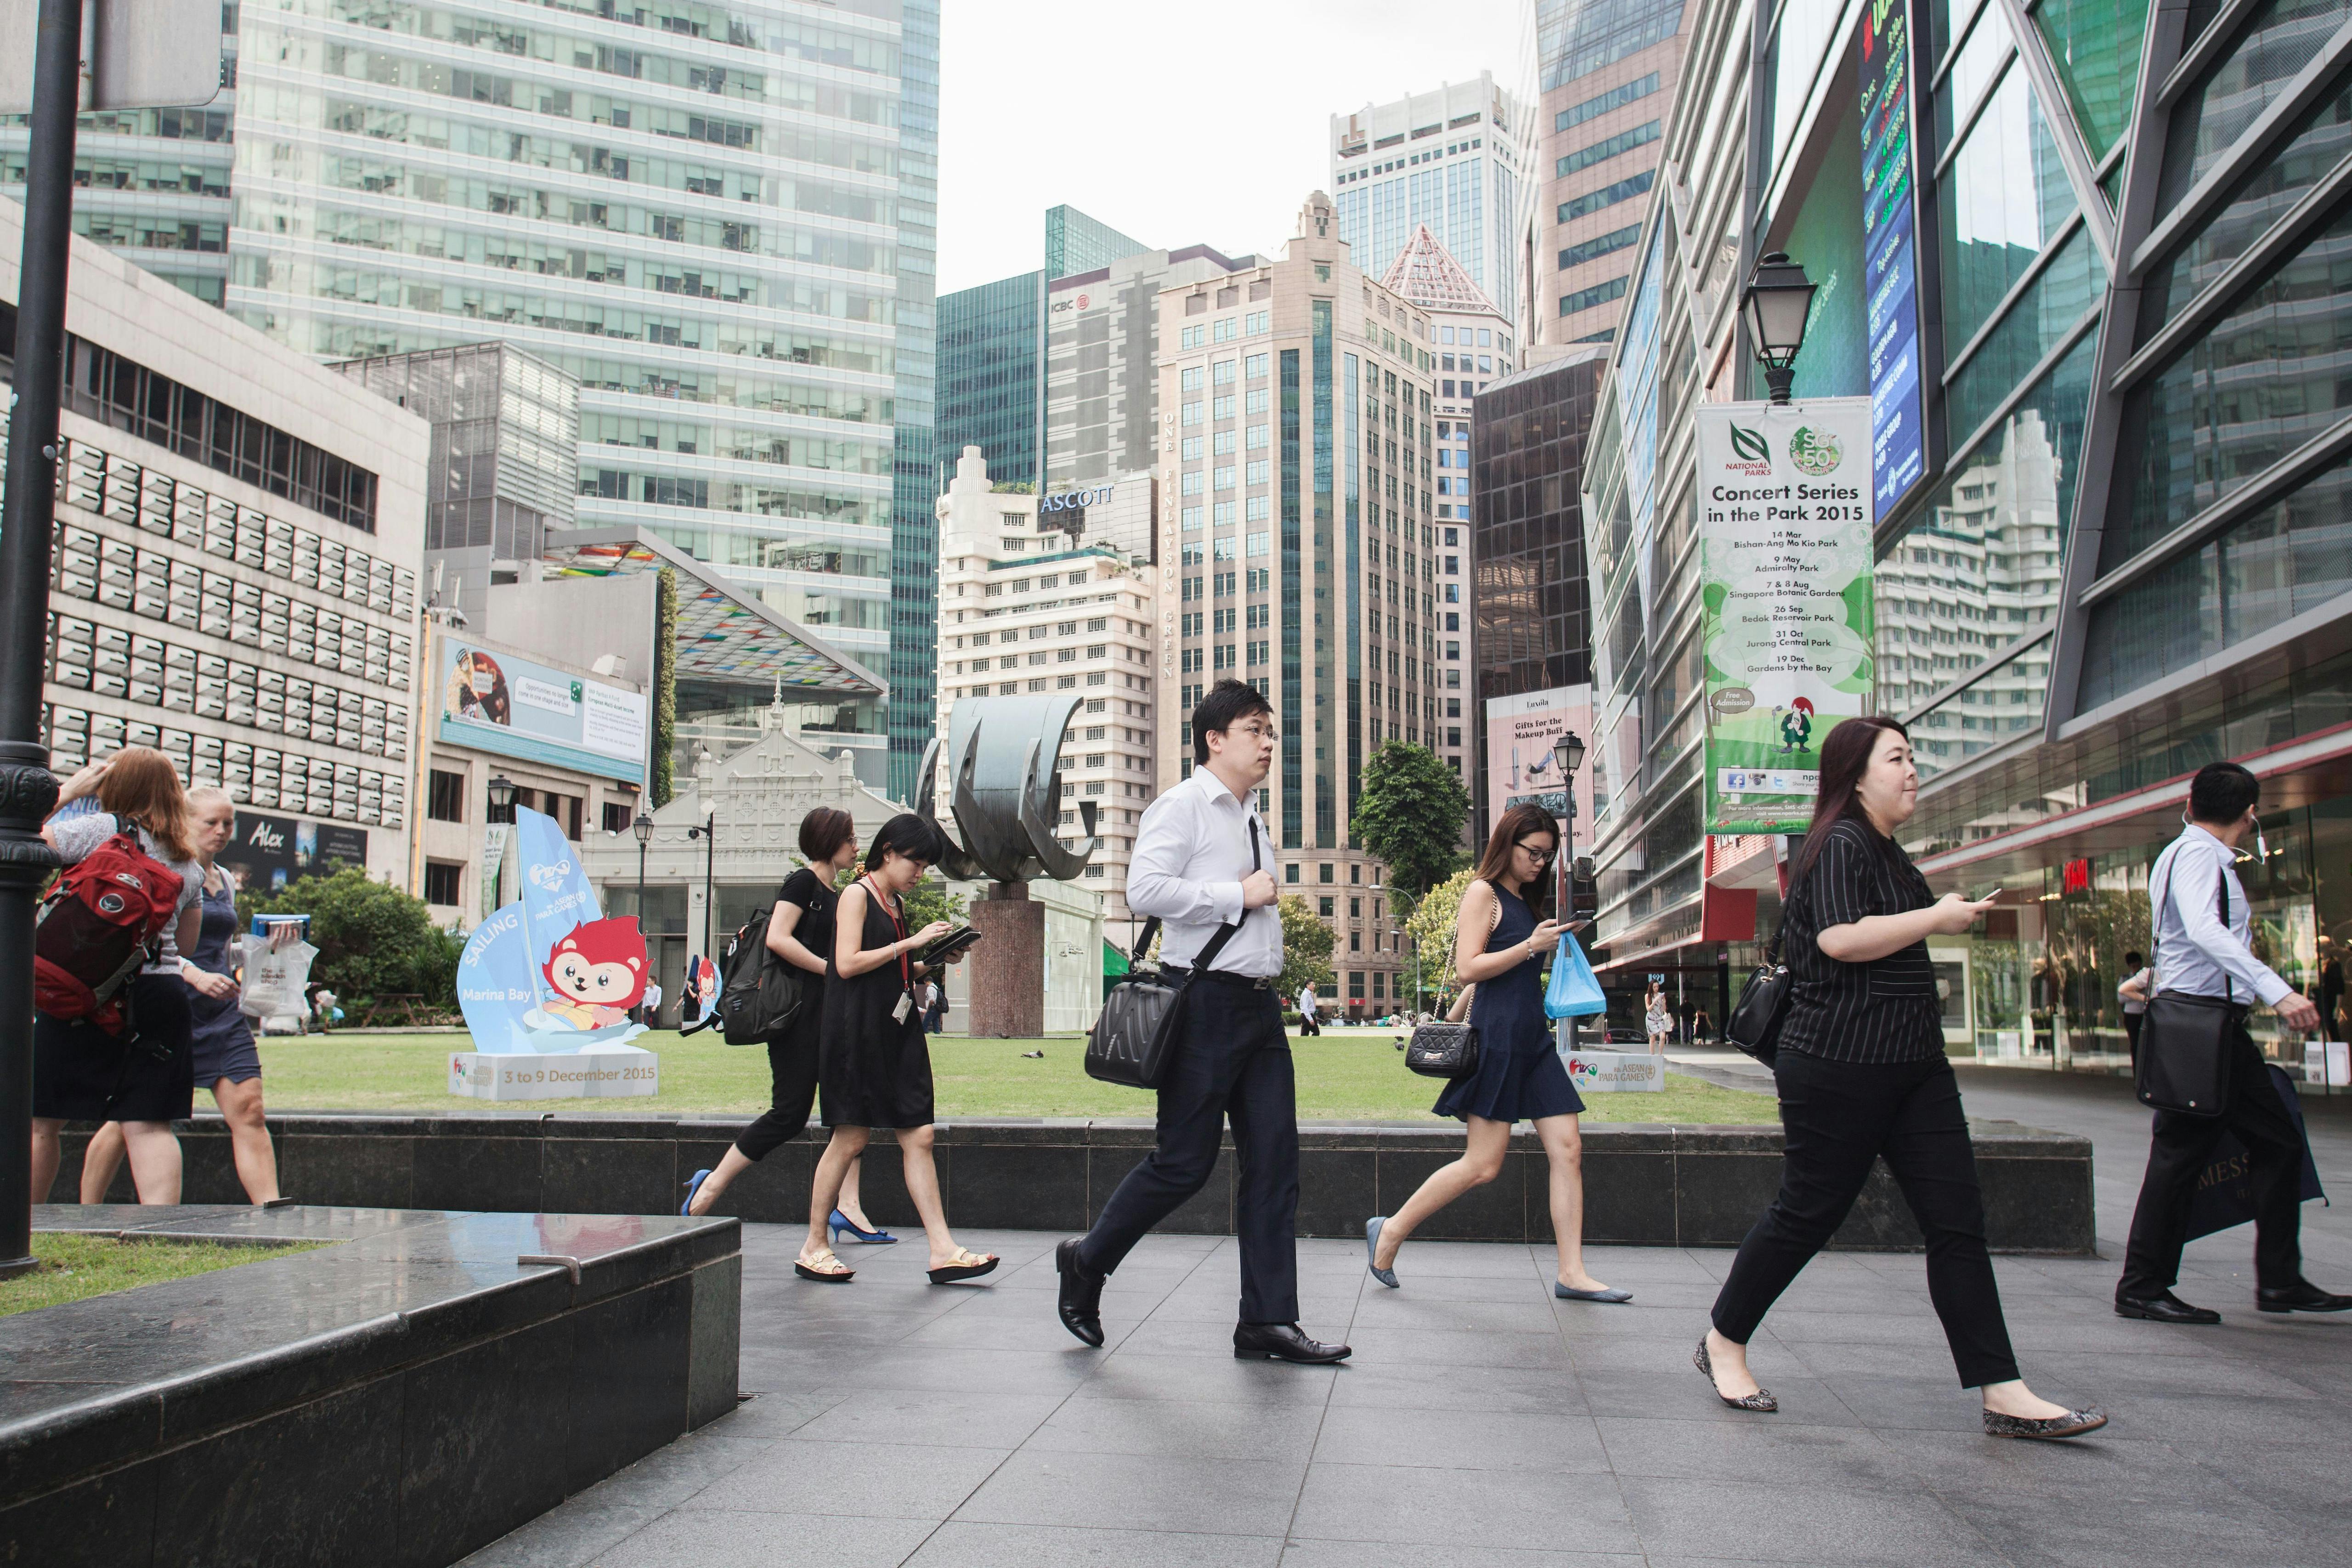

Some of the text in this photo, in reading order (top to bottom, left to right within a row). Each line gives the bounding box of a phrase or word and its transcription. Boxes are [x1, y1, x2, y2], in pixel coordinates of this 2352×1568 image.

[1051, 299, 1074, 314] ICBC
[1803, 432, 1831, 449] SG
[1875, 411, 1902, 456] NOBLE GROUP
[1804, 450, 1831, 468] 50
[1712, 483, 1859, 501] Concert Series
[1040, 485, 1114, 514] ASCOTT
[1707, 506, 1863, 522] in the Park 2015
[1163, 413, 1175, 679] ONE FINLAYSON GREEN
[1734, 541, 1784, 549] Bishan-Ang
[1783, 556, 1800, 565] May
[1793, 581, 1809, 589] Aug
[1730, 590, 1774, 599] Singapore
[1789, 606, 1803, 614] Sep
[1747, 640, 1776, 648] Jurong
[1816, 665, 1832, 674] Bay
[526, 683, 551, 697] Opportunities
[558, 691, 569, 701] longer
[543, 696, 553, 706] shape
[1515, 719, 1533, 730] Gifts
[1515, 727, 1563, 740] Makeup Buff
[249, 821, 285, 848] Alex
[554, 893, 575, 906] ASEAN
[535, 909, 554, 921] PARA
[554, 900, 577, 913] GAMES
[465, 914, 519, 968] SAILING
[463, 989, 531, 1003] Marina Bay
[504, 1067, 656, 1083] 3 to 9 December 2015
[1623, 1064, 1645, 1072] ASEAN
